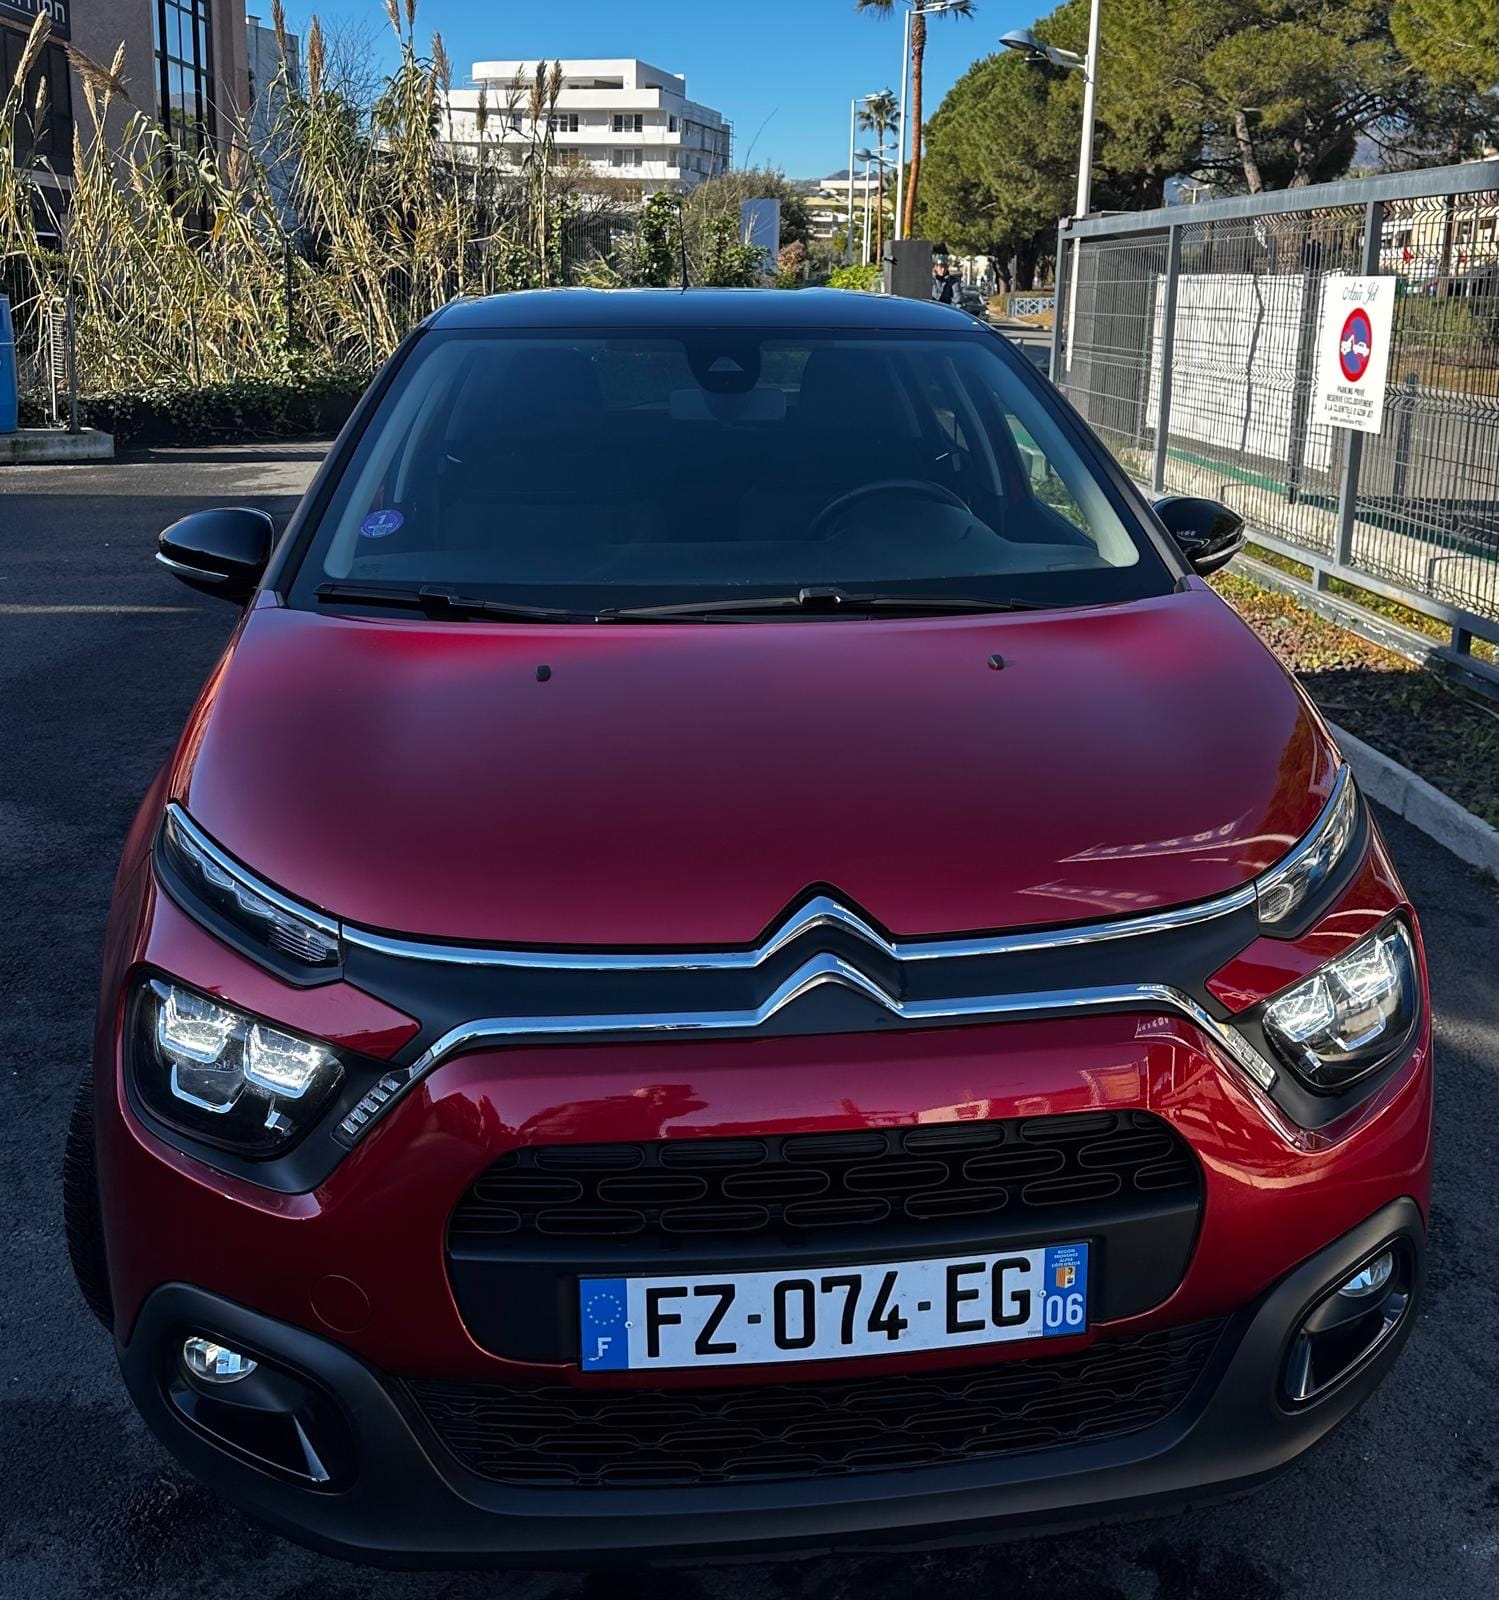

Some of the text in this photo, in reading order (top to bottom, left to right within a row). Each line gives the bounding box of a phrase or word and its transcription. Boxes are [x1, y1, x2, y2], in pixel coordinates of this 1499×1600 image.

[645, 1256, 1032, 1358] FZ-074-EG
[1046, 1293, 1083, 1327] 06
[597, 1336, 613, 1357] F
